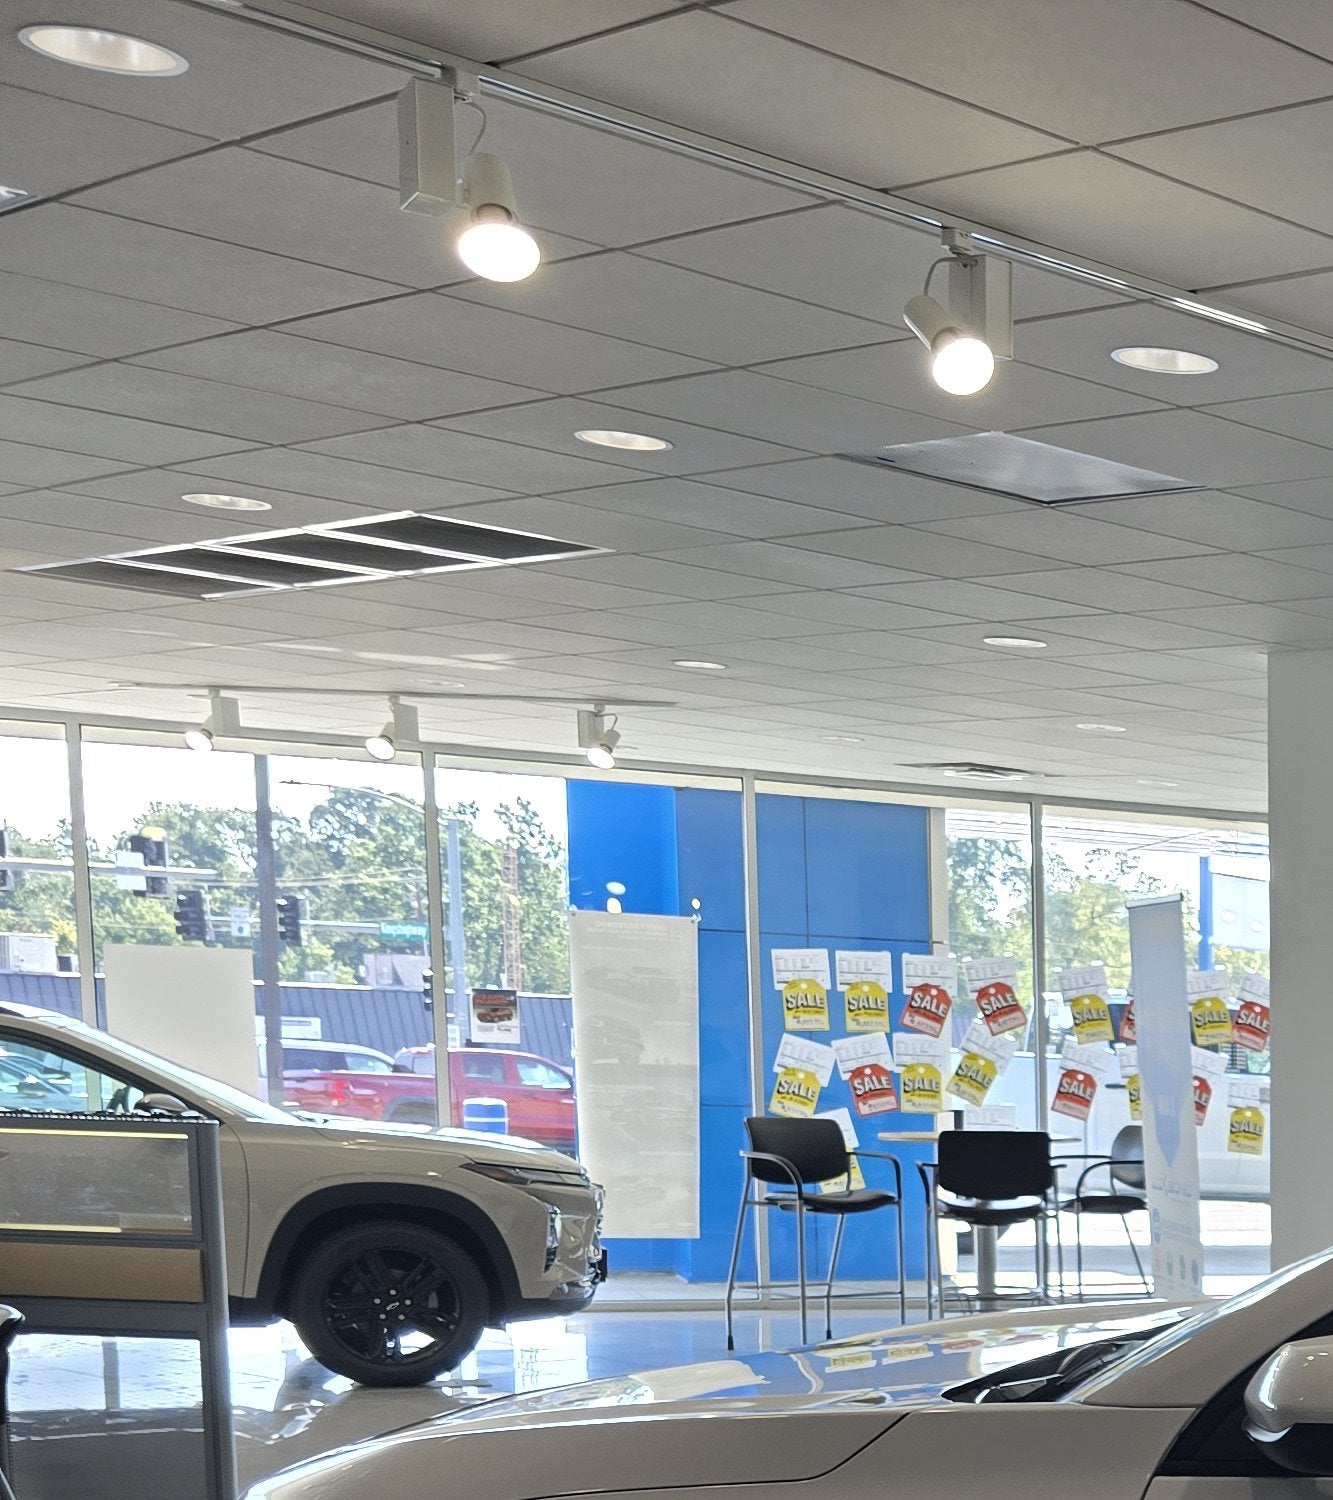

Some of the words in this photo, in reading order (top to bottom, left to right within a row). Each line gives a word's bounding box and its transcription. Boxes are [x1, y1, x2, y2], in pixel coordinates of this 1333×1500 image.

[786, 992, 825, 1010] SALE
[848, 994, 886, 1012] SALE
[910, 992, 948, 1018] SALE
[981, 993, 1018, 1016] SALE
[1073, 1007, 1108, 1026] SALE
[1195, 1010, 1229, 1028] SALE
[1237, 1010, 1270, 1033] SALE
[854, 1076, 892, 1096] SALE
[904, 1076, 940, 1093] SALE
[956, 1063, 993, 1089] SALE
[778, 1080, 816, 1102] SALE
[1058, 1078, 1095, 1102] SALE
[1230, 1119, 1263, 1136] SALE
